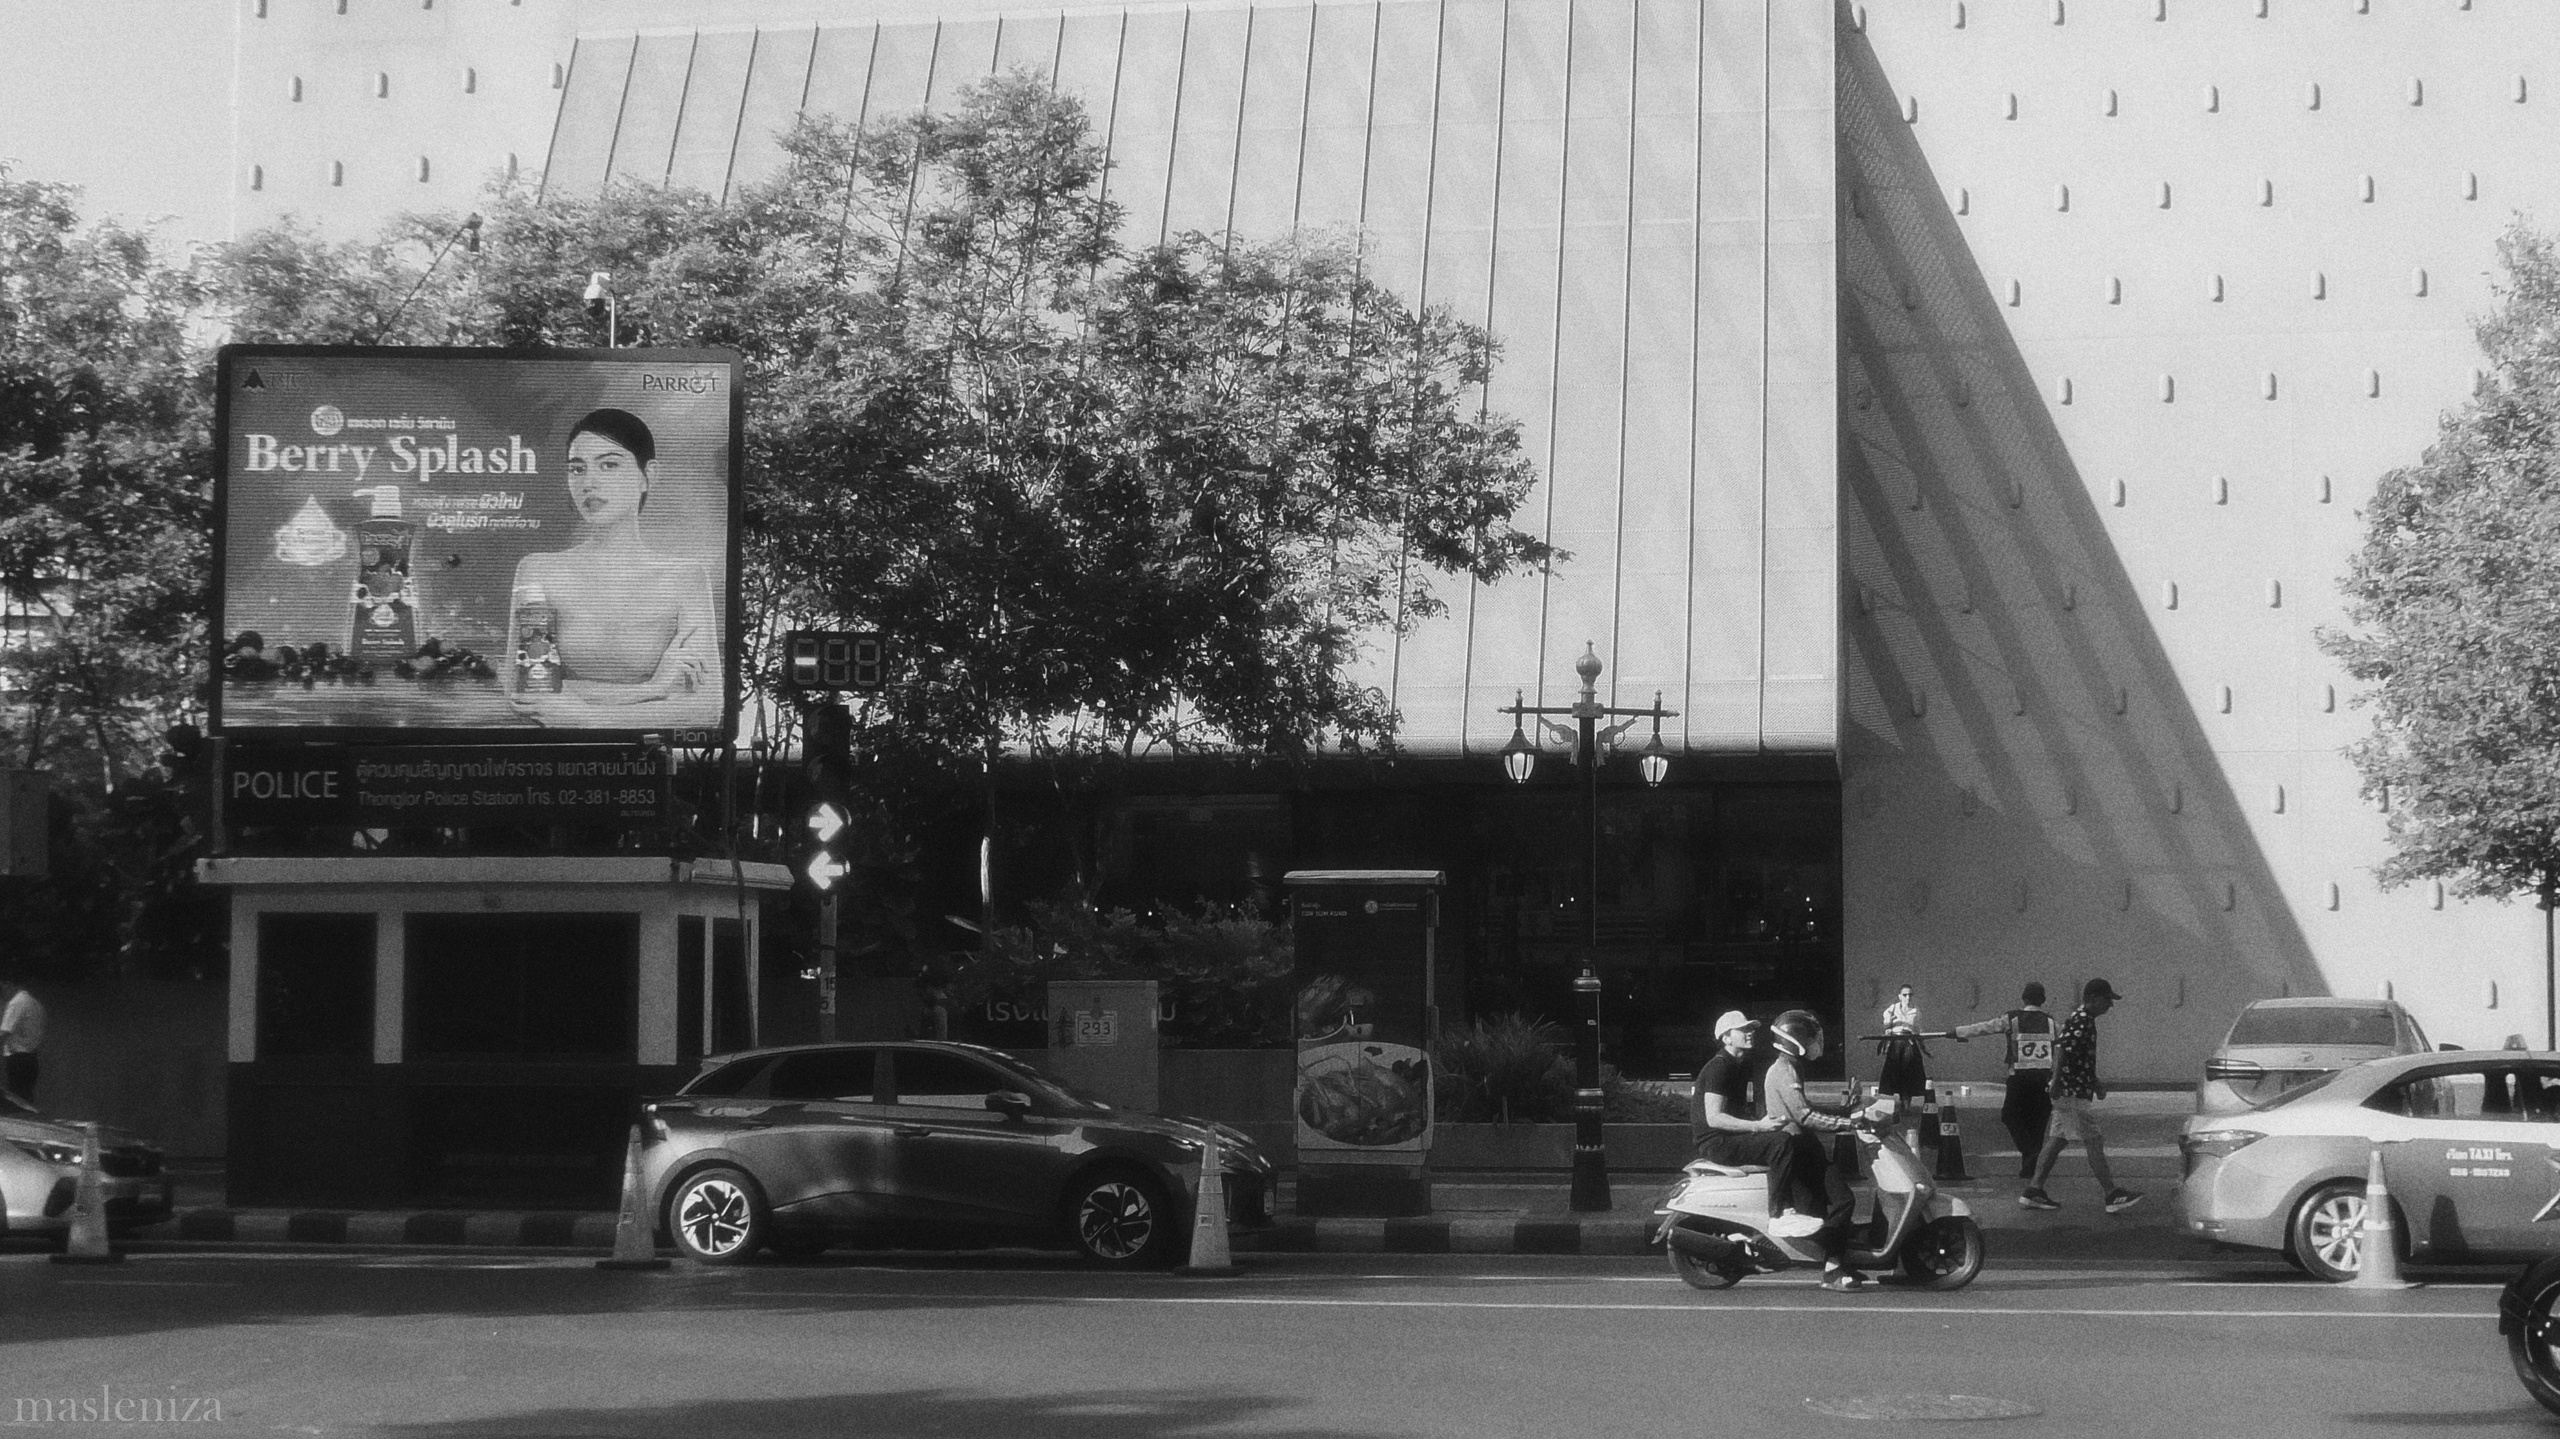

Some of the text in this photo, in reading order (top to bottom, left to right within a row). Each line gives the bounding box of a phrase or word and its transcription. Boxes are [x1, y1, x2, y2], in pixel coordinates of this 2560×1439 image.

[642, 370, 720, 394] PARROT
[244, 433, 539, 482] Berry Splash
[232, 770, 340, 799] POLICE
[472, 789, 524, 806] Station
[558, 788, 656, 806] 02-381-8853
[1080, 1021, 1112, 1036] 293
[2468, 1147, 2494, 1161] TAXI
